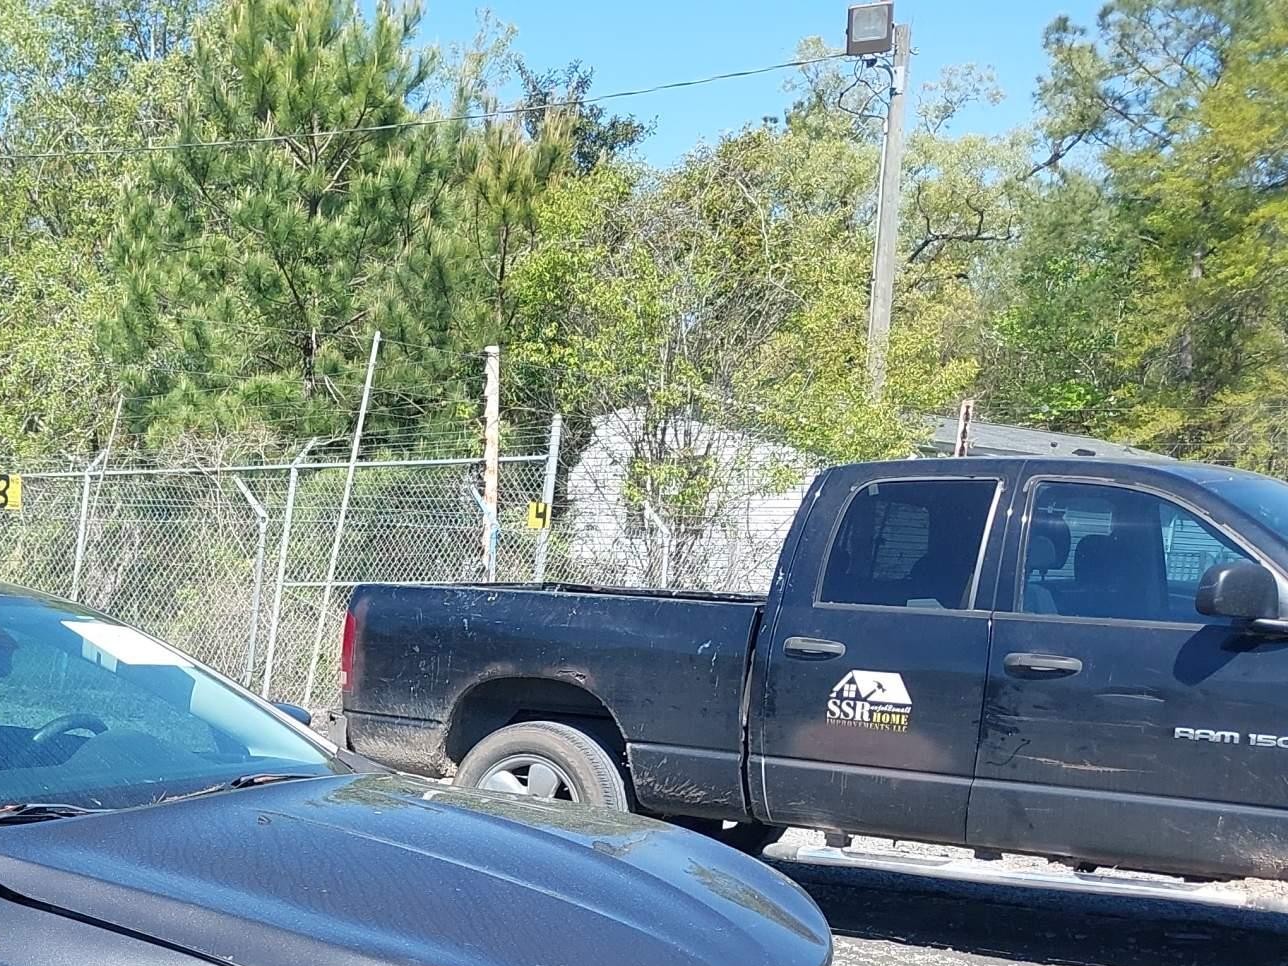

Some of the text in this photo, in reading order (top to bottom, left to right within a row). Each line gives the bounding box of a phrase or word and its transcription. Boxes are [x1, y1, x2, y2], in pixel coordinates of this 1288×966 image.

[534, 501, 548, 528] 4
[826, 698, 871, 722] SSR
[872, 711, 909, 726] HOME
[1174, 727, 1240, 744] RAM
